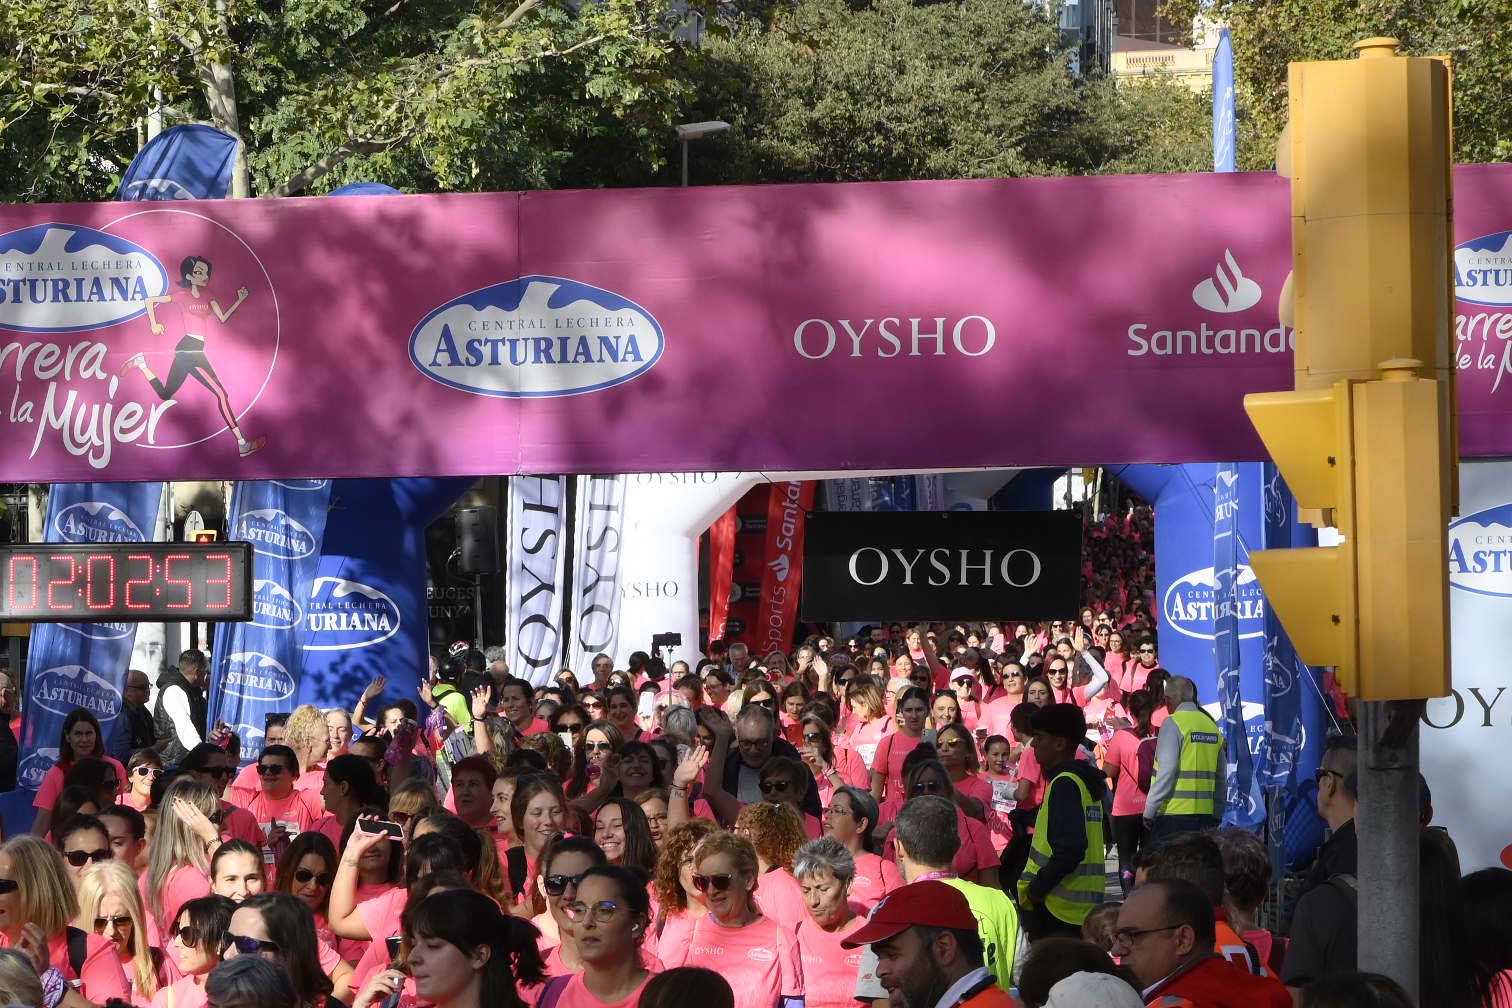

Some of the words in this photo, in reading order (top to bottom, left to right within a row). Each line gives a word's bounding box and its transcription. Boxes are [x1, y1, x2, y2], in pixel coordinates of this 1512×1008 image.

[71, 260, 143, 272] LECHERA
[1454, 261, 1512, 287] ASTU
[468, 319, 547, 332] CENTRAL
[554, 316, 637, 330] LECHERA
[794, 315, 996, 360] OYSHO
[429, 323, 644, 367] ASTURIANA
[1477, 342, 1496, 369] la
[9, 386, 35, 423] la
[29, 377, 178, 469] Mujer
[240, 521, 307, 553] ASTURIANA
[10, 554, 232, 608] 02:02:53
[848, 547, 1042, 587] OYSHO
[338, 602, 387, 610] LECHERA
[36, 679, 116, 715] ASTURIANA
